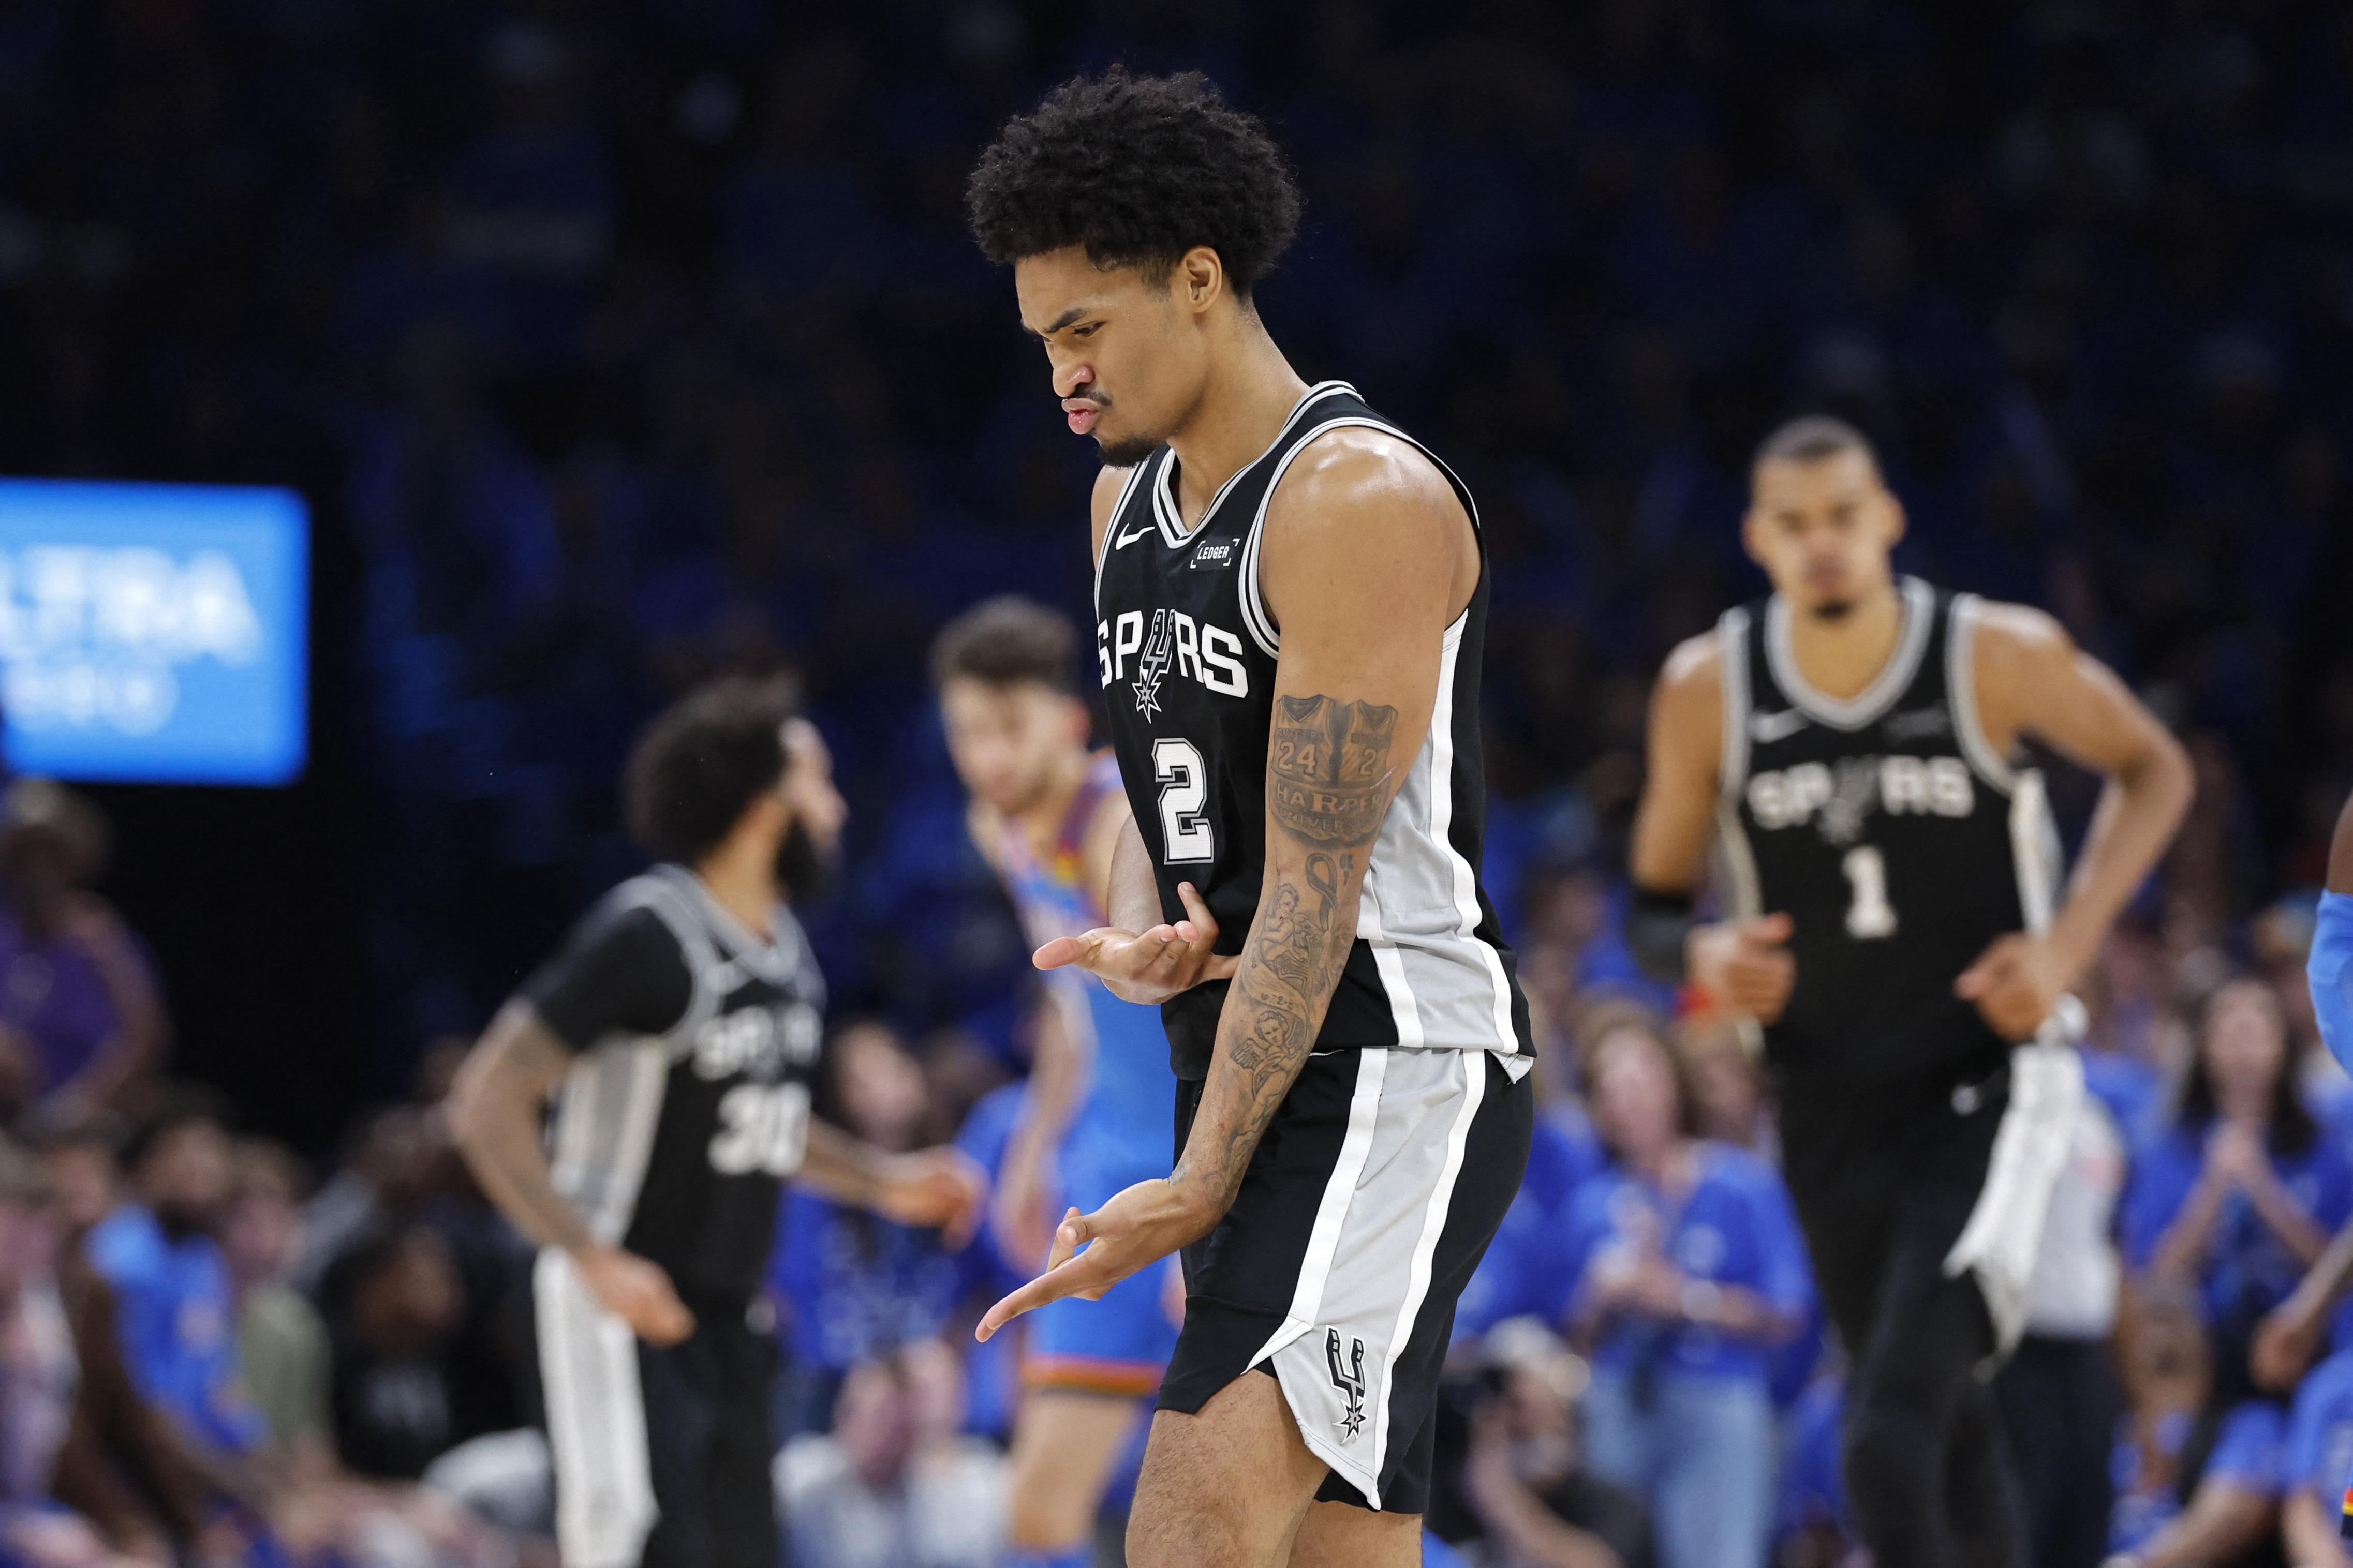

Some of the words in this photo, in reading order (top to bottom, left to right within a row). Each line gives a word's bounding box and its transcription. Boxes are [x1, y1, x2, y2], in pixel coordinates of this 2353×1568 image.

[1197, 546, 1230, 560] LEDGER
[1278, 741, 1316, 774] 24
[1358, 748, 1377, 775] 2
[1151, 738, 1214, 865] 2
[1843, 845, 1898, 940] 1
[708, 1081, 811, 1173] 30
